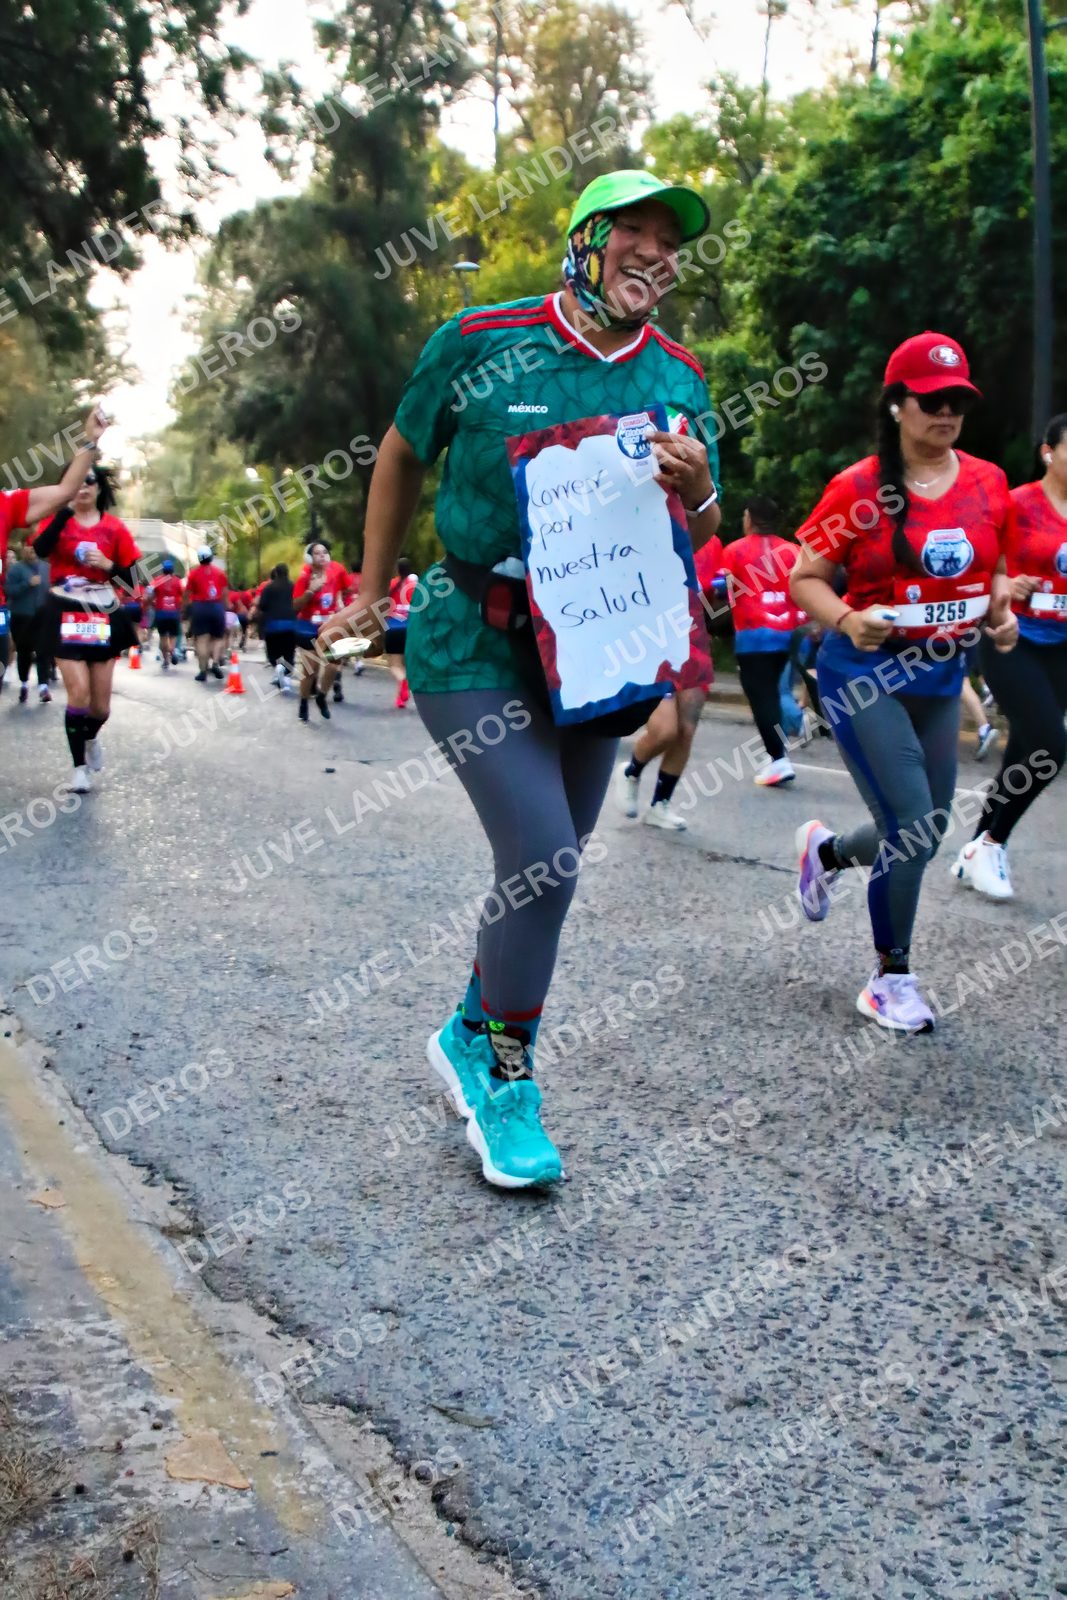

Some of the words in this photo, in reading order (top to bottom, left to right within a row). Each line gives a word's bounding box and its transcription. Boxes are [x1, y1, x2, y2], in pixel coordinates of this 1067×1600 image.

[540, 515, 572, 551] por
[536, 543, 641, 584] nuestra
[924, 601, 967, 623] 3259
